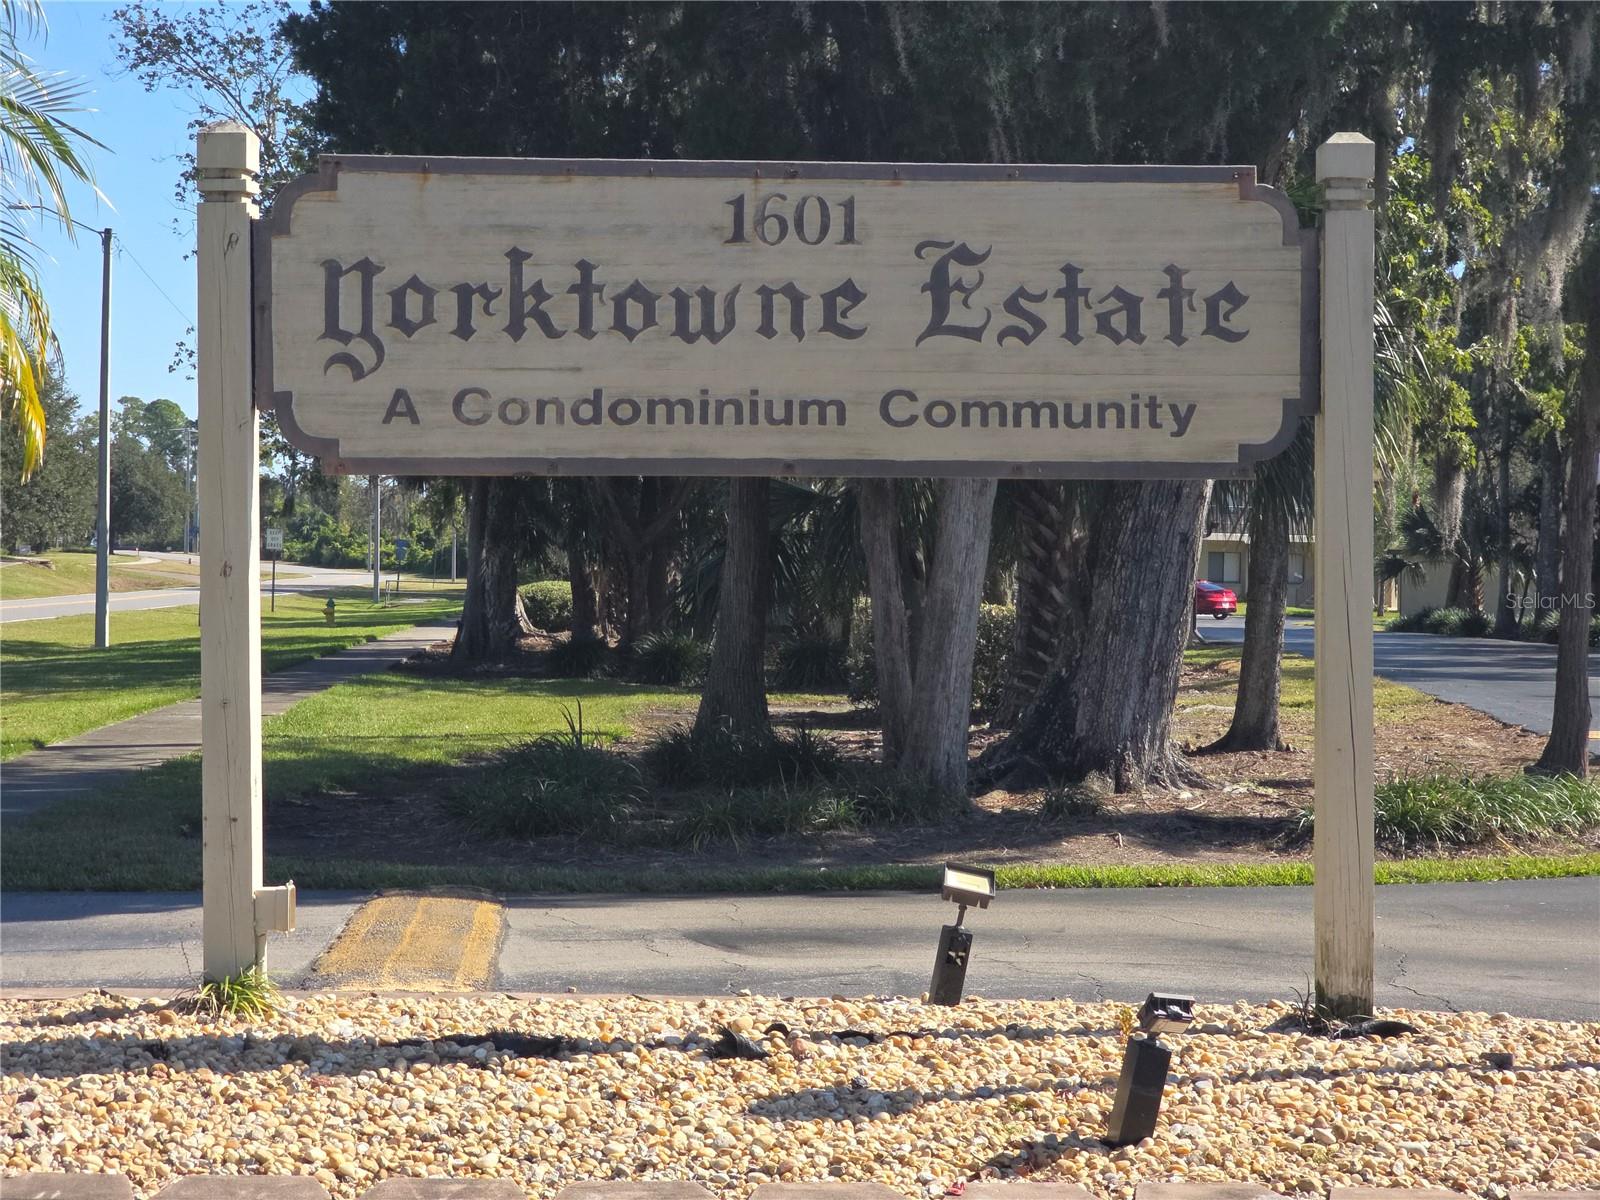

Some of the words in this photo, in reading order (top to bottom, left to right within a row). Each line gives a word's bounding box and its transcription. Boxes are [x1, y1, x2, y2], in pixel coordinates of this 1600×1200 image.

[723, 193, 863, 246] 1601
[318, 246, 868, 382] Yorktowne
[913, 240, 1251, 348] Estate
[382, 388, 420, 425] A
[452, 387, 847, 426] Condominium
[879, 389, 1198, 438] Community
